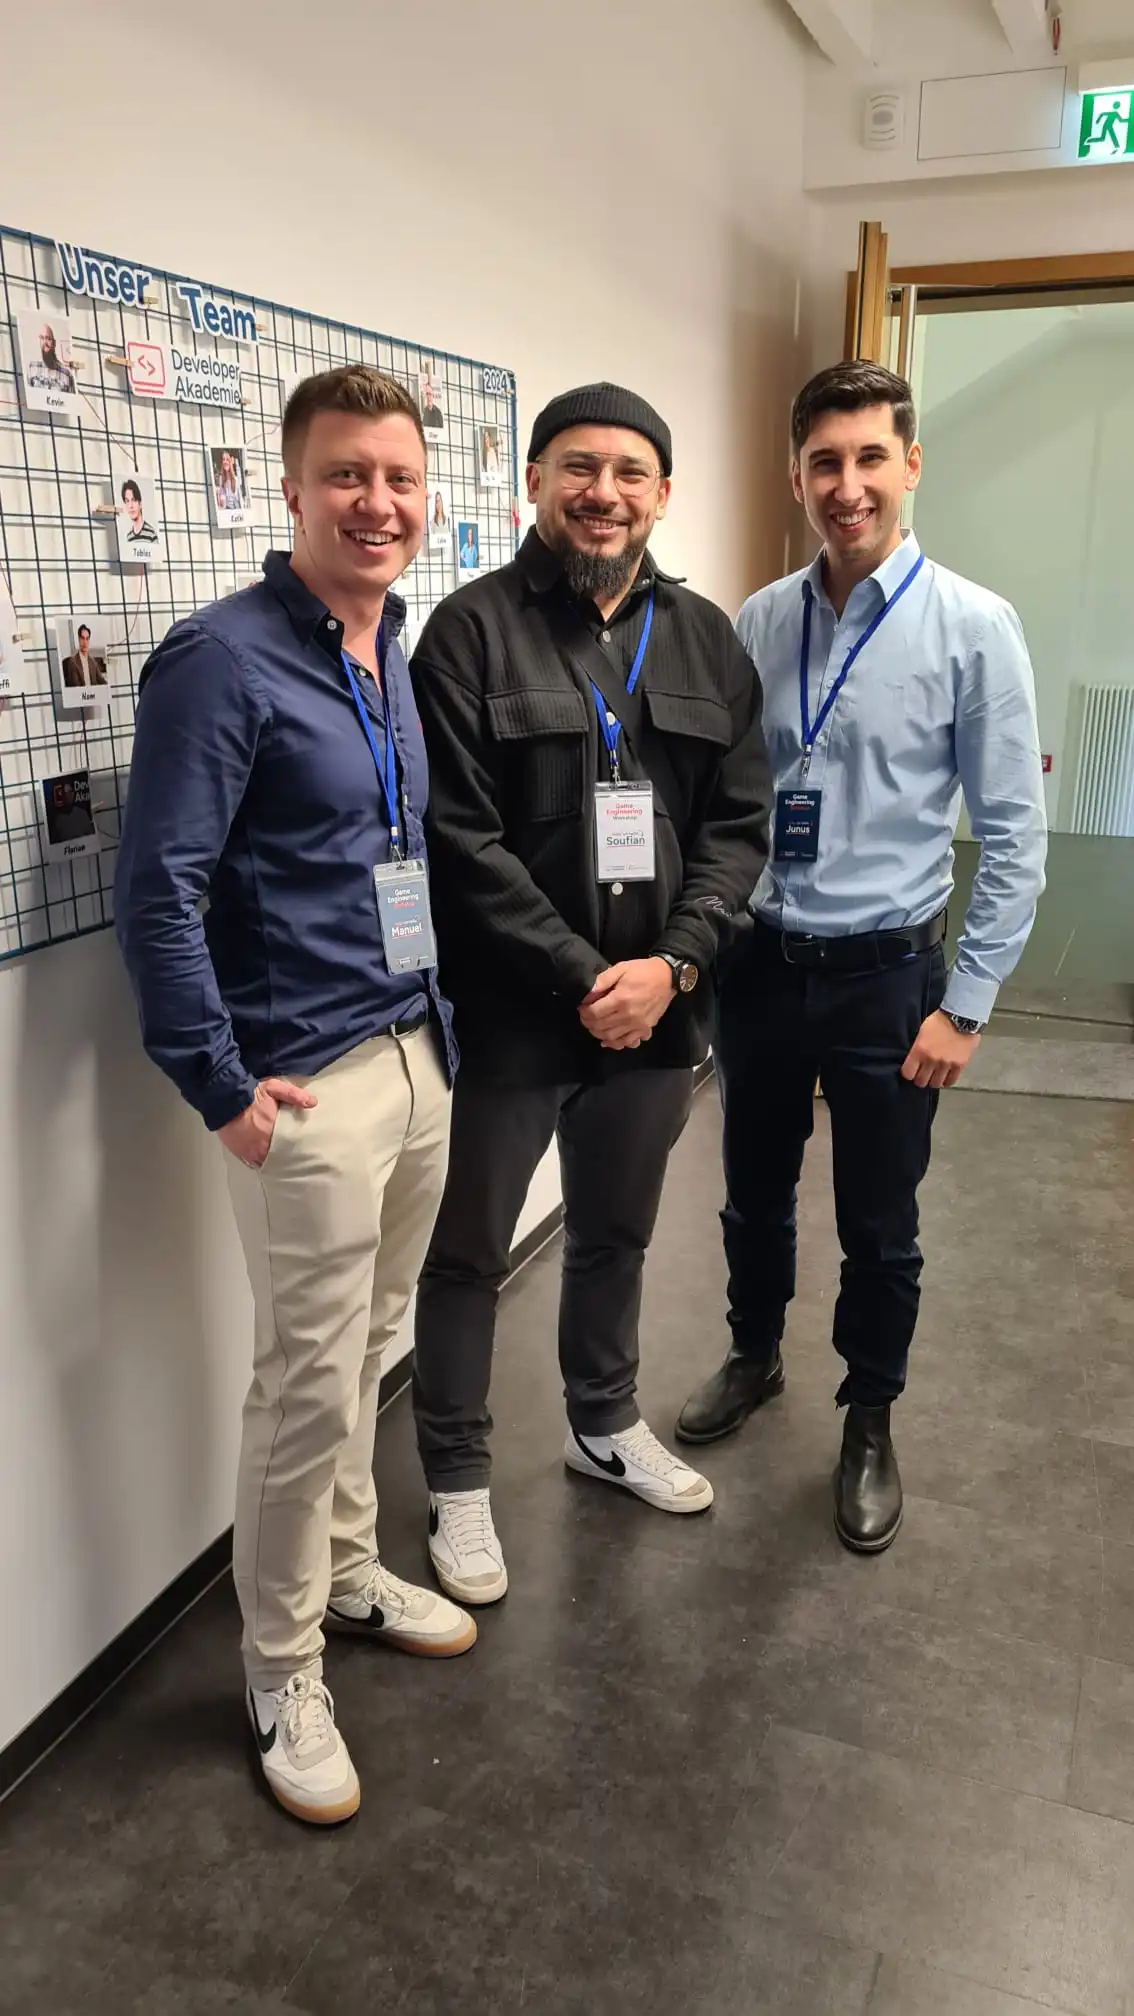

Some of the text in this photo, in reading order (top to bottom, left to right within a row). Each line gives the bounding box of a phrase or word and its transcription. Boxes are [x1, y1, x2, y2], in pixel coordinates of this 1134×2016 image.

[57, 241, 257, 341] Unser Team
[171, 348, 240, 382] Developer
[484, 369, 508, 392] 2024
[175, 374, 240, 404] Akademie
[46, 395, 64, 407] Kevin
[133, 548, 152, 558] Tobias
[786, 825, 810, 833] Junus
[606, 836, 646, 846] Soufian
[394, 888, 411, 896] Game
[387, 894, 419, 904] Engineering
[391, 923, 422, 936] Manuel
